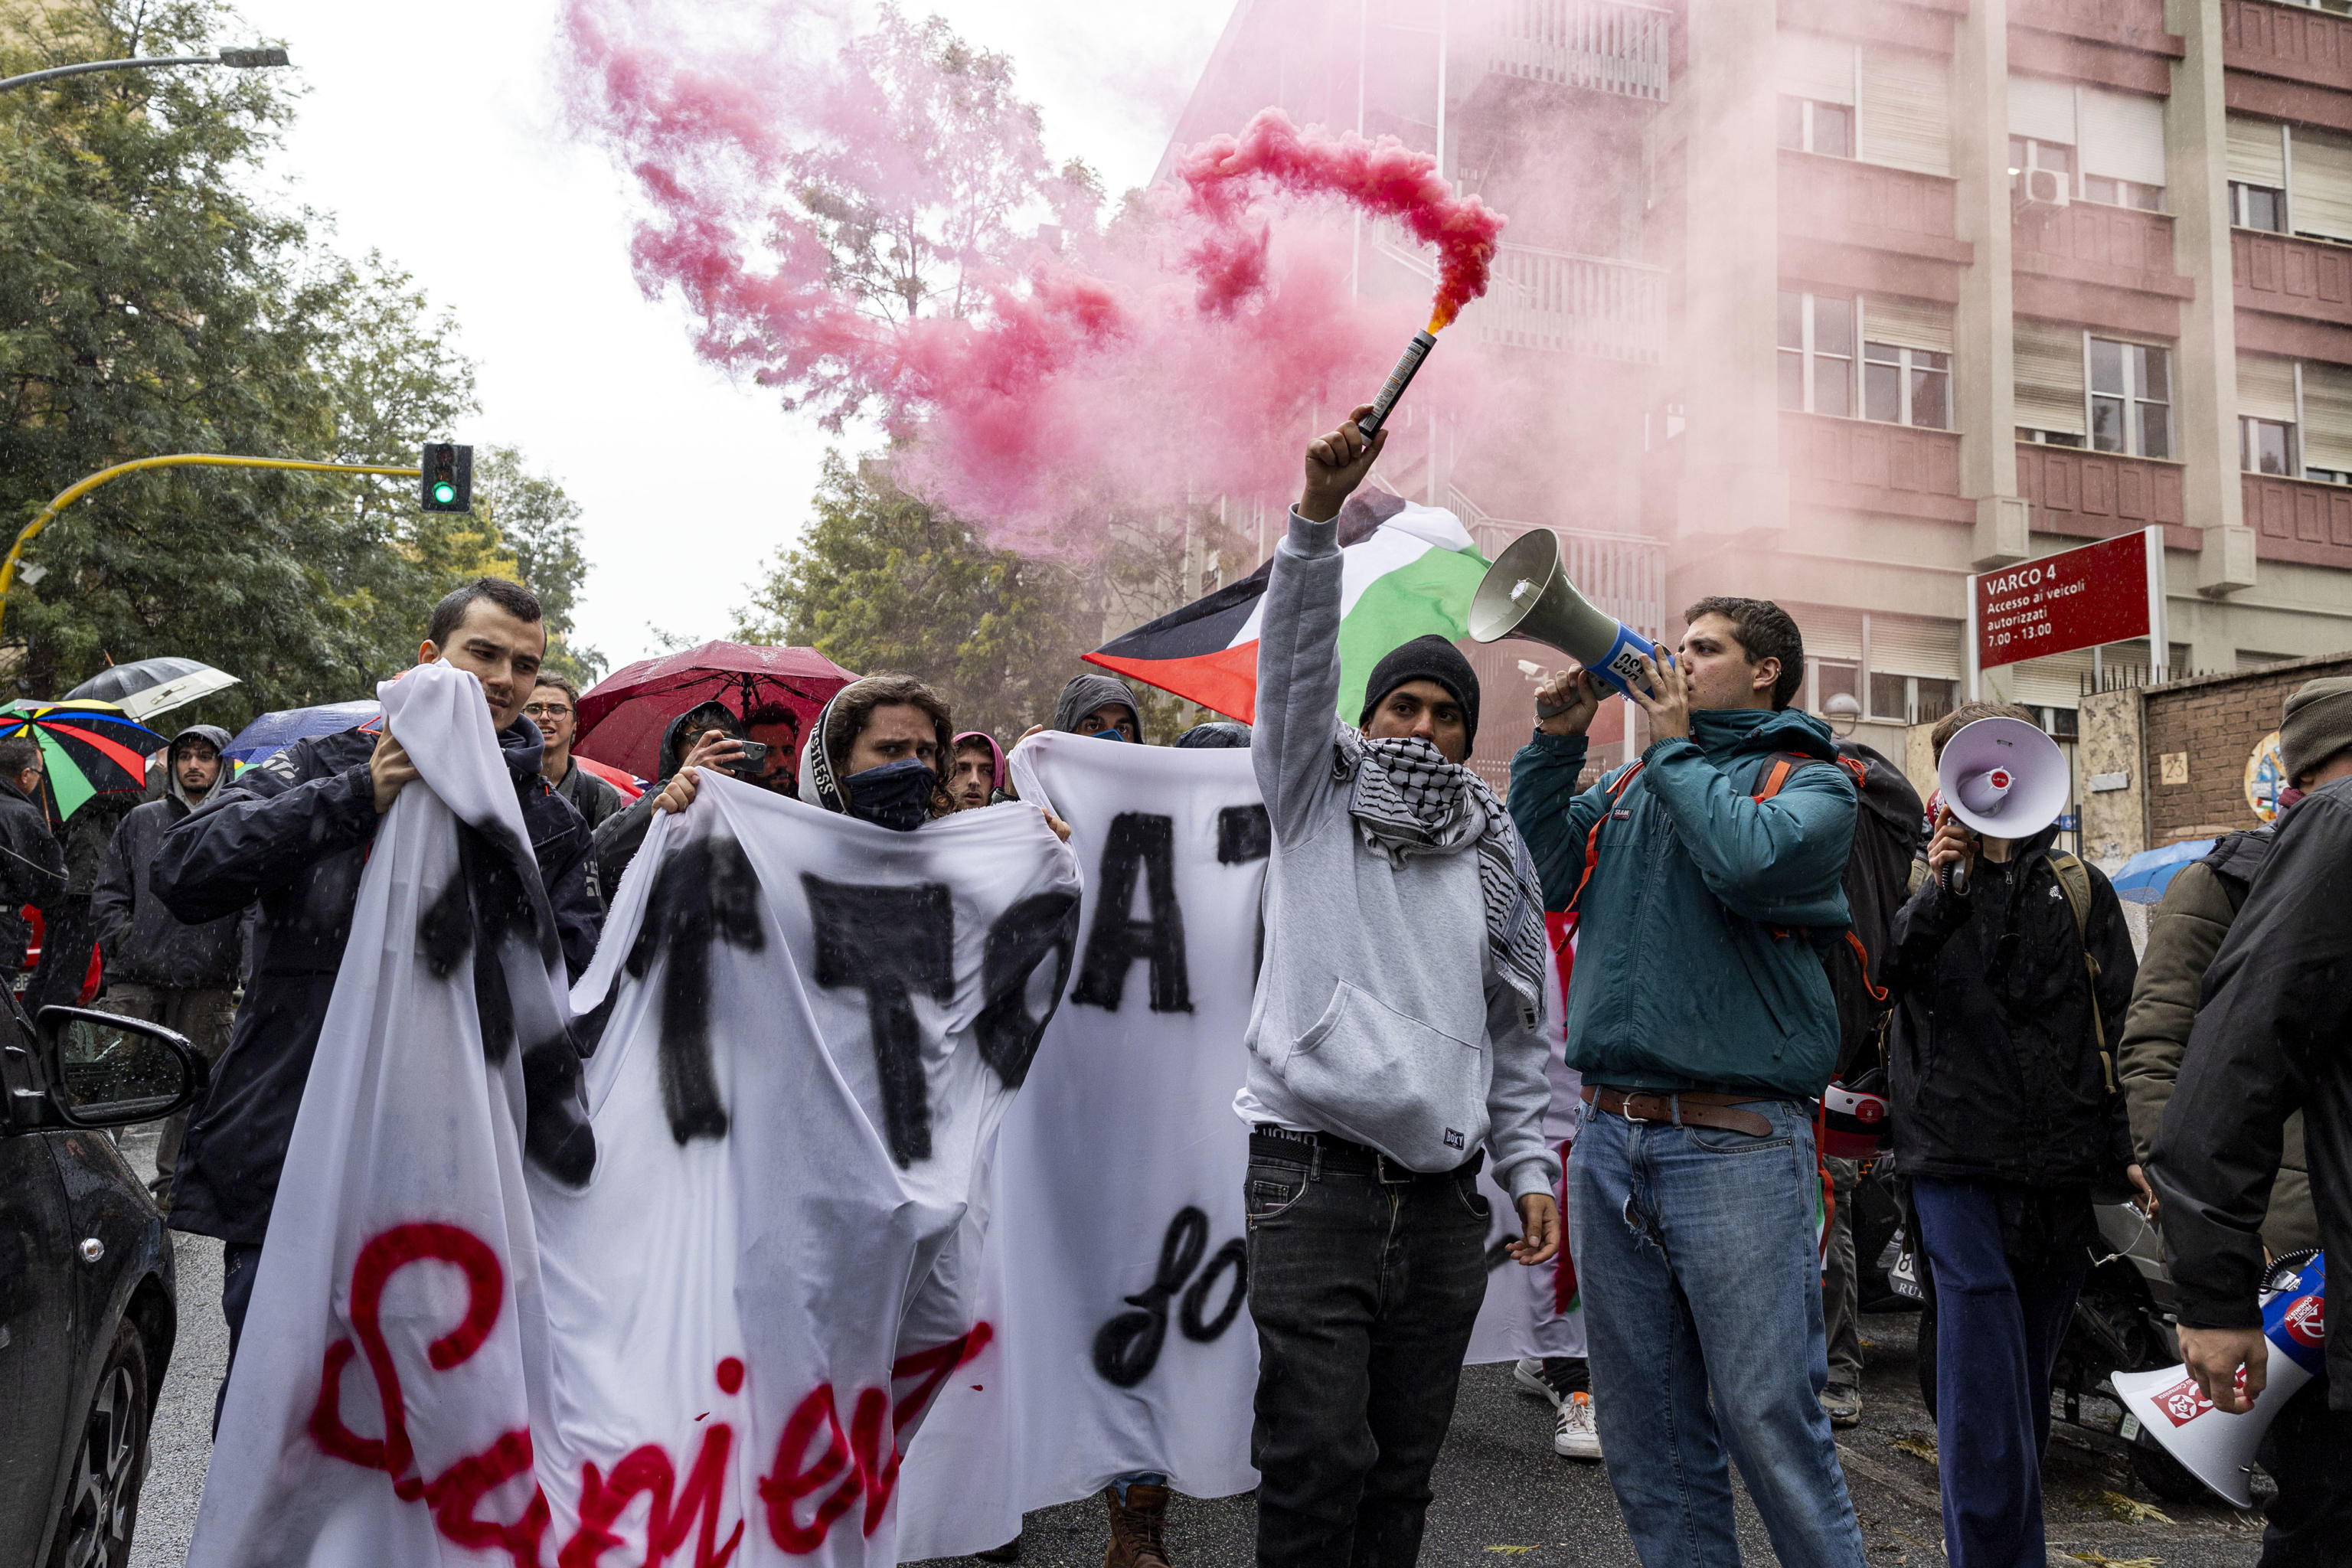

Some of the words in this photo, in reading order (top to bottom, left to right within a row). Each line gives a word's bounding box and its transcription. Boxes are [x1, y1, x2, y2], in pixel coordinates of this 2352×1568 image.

[1986, 568, 2041, 596] VARCO
[2047, 564, 2056, 580] 4
[1987, 596, 2030, 615] Accesso
[2033, 589, 2043, 603] ai
[2046, 578, 2085, 599] veicoli
[1988, 605, 2047, 631] autorizzati
[1988, 632, 2011, 647] 7.00
[2021, 622, 2052, 639] 13.00
[2165, 759, 2185, 779] 23
[2285, 1296, 2313, 1321] COMUNISTA
[2293, 1304, 2312, 1322] FRONTE
[2158, 1383, 2187, 1400] Comunista
